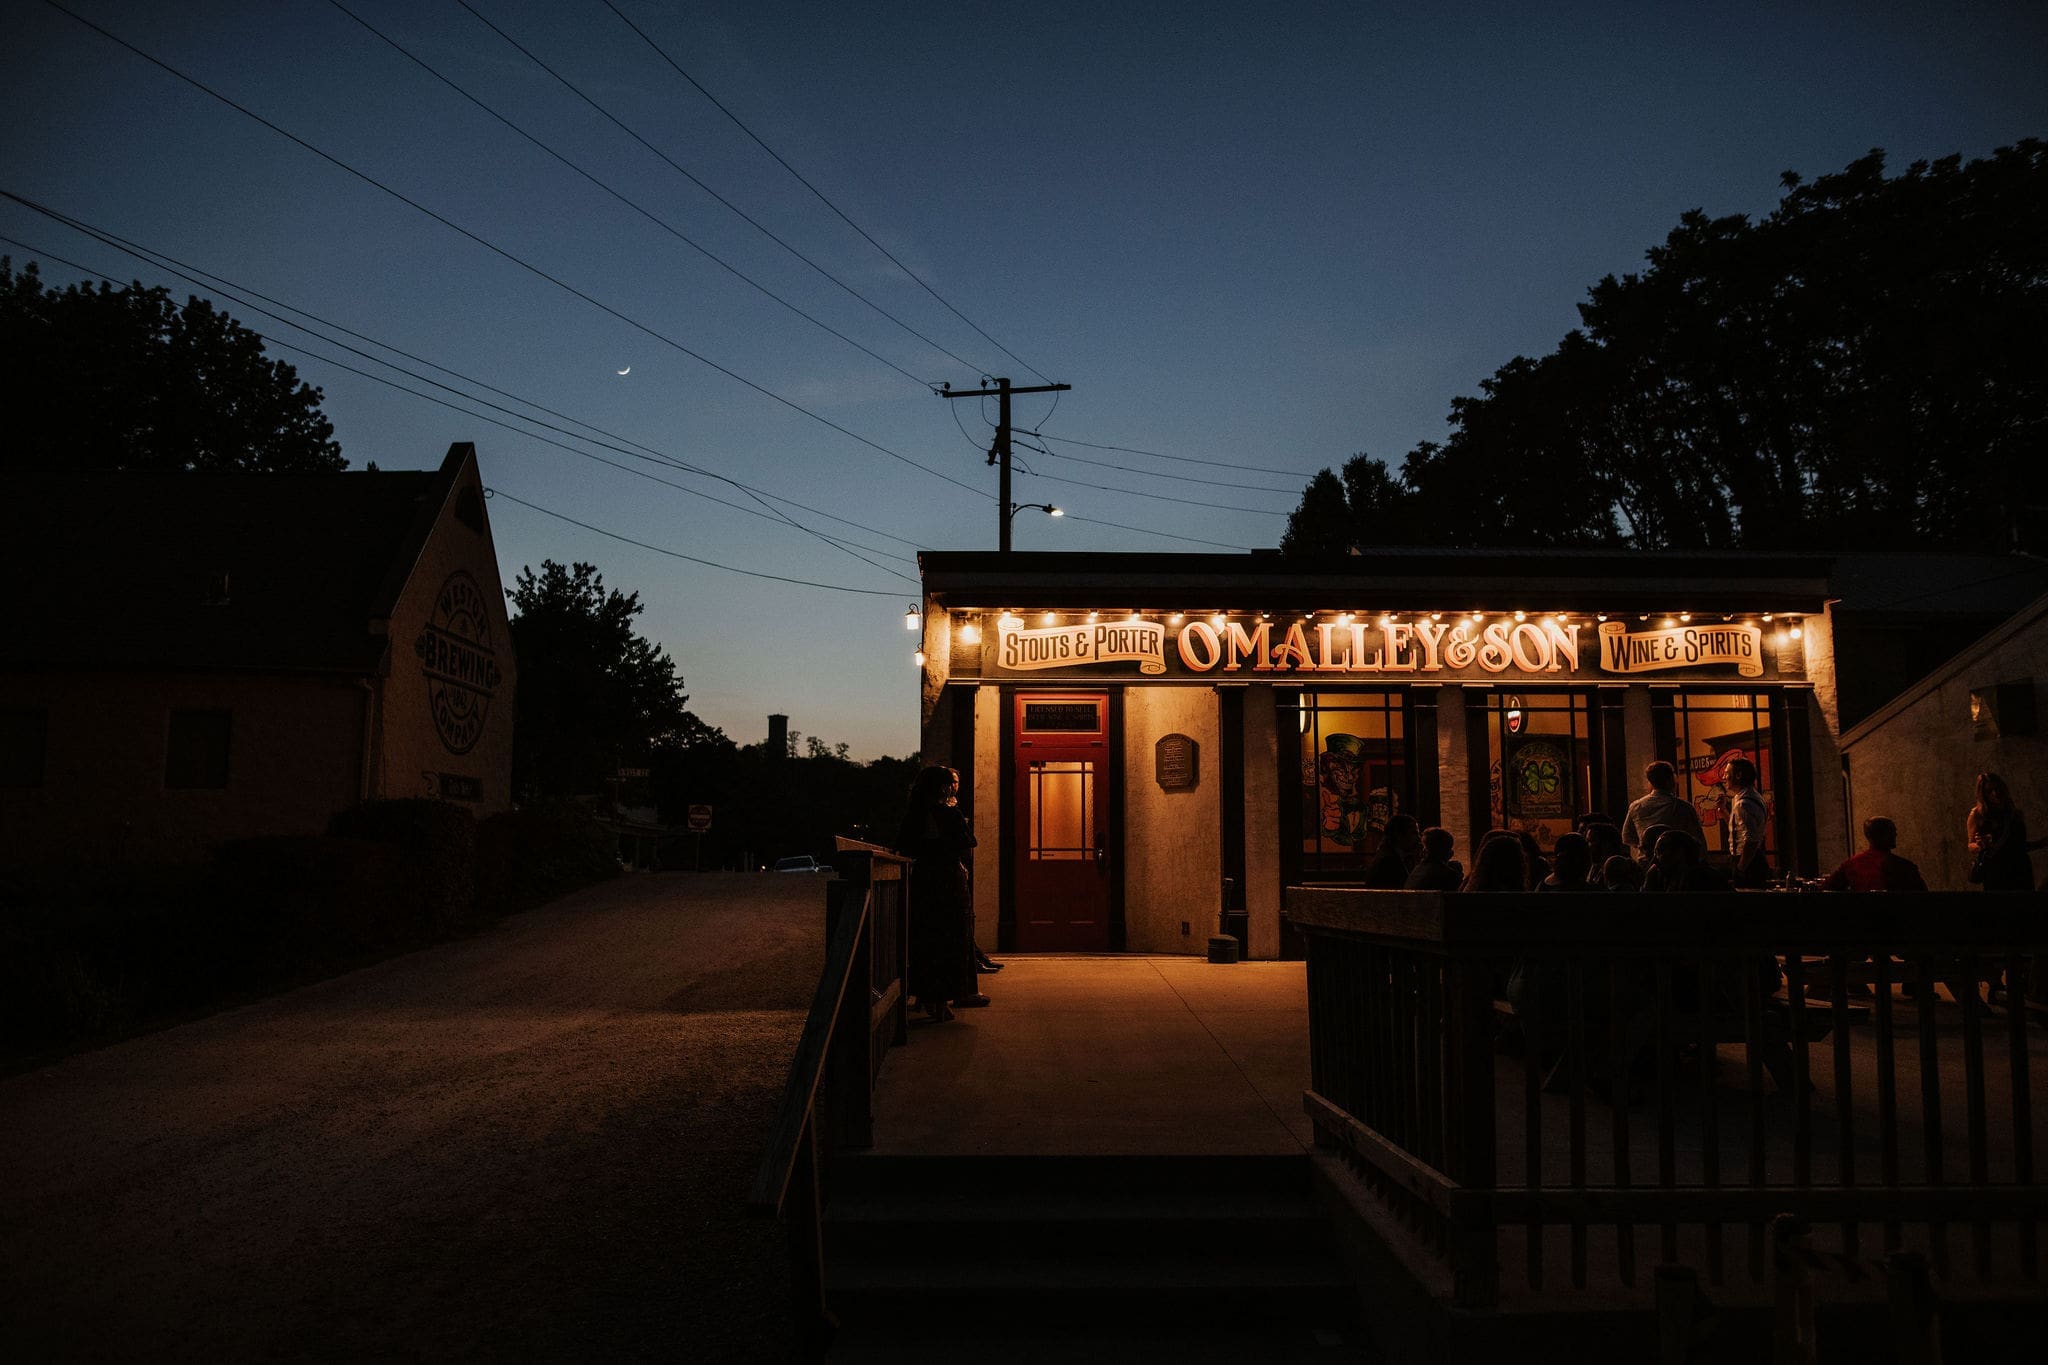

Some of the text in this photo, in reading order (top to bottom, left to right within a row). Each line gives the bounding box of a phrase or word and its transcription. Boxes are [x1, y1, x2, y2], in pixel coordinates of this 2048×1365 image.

[440, 584, 487, 636] WESTON
[425, 630, 493, 688] BREWING
[1006, 625, 1159, 667] STOUTS & PORTER
[1609, 629, 1752, 671] WINE & SPIRITS
[435, 689, 481, 745] COMPANY
